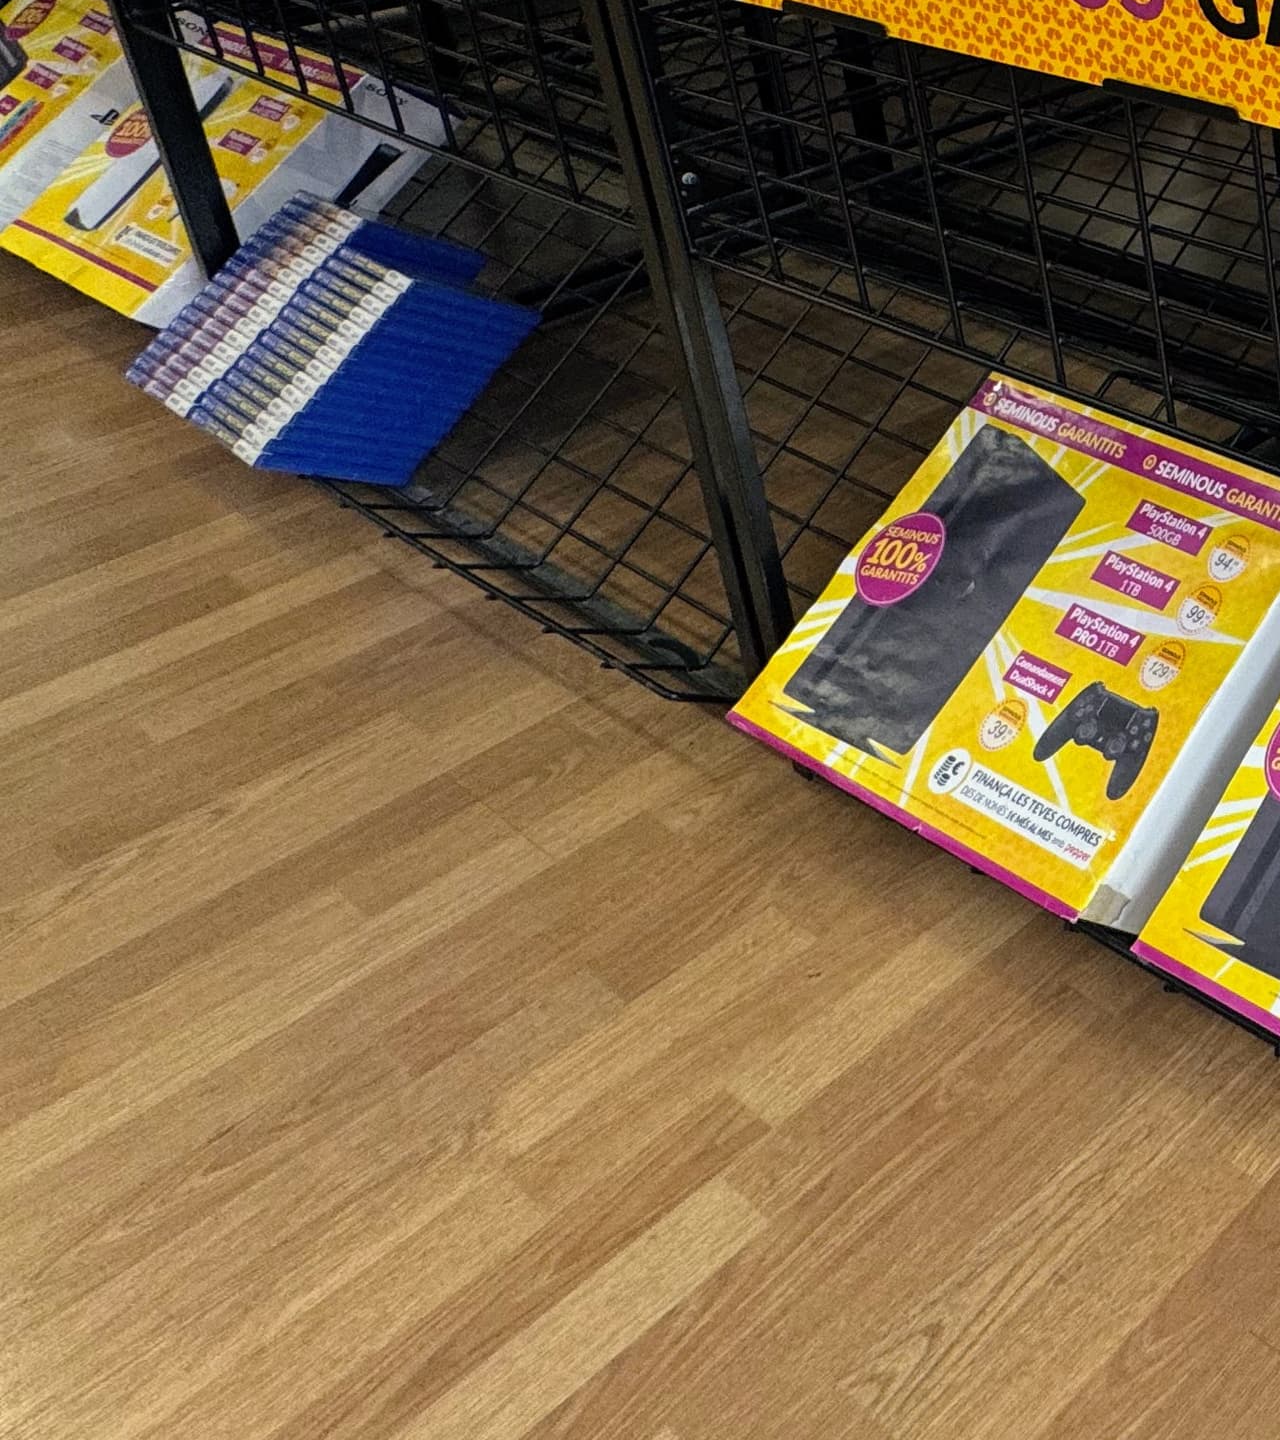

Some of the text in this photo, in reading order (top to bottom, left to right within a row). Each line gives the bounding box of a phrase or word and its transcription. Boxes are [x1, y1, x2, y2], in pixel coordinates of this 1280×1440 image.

[995, 393, 1058, 433] SEMINOUS
[1057, 422, 1128, 461] GARANTITS
[1155, 459, 1227, 500] SEMINOUS
[885, 526, 942, 544] SEMINOUS
[1141, 503, 1206, 538] PlayStation 4
[1148, 524, 1182, 546] 500GB
[866, 538, 932, 572] 100%
[861, 565, 919, 585] GARANTITS
[1105, 553, 1175, 593] PlayStation 4
[1119, 582, 1142, 597] 1TB
[1070, 608, 1140, 648] PlayStation 4
[1070, 627, 1119, 658] PRO 1TB
[972, 769, 1102, 847] FINANÇA LES TEVES COMPRES
